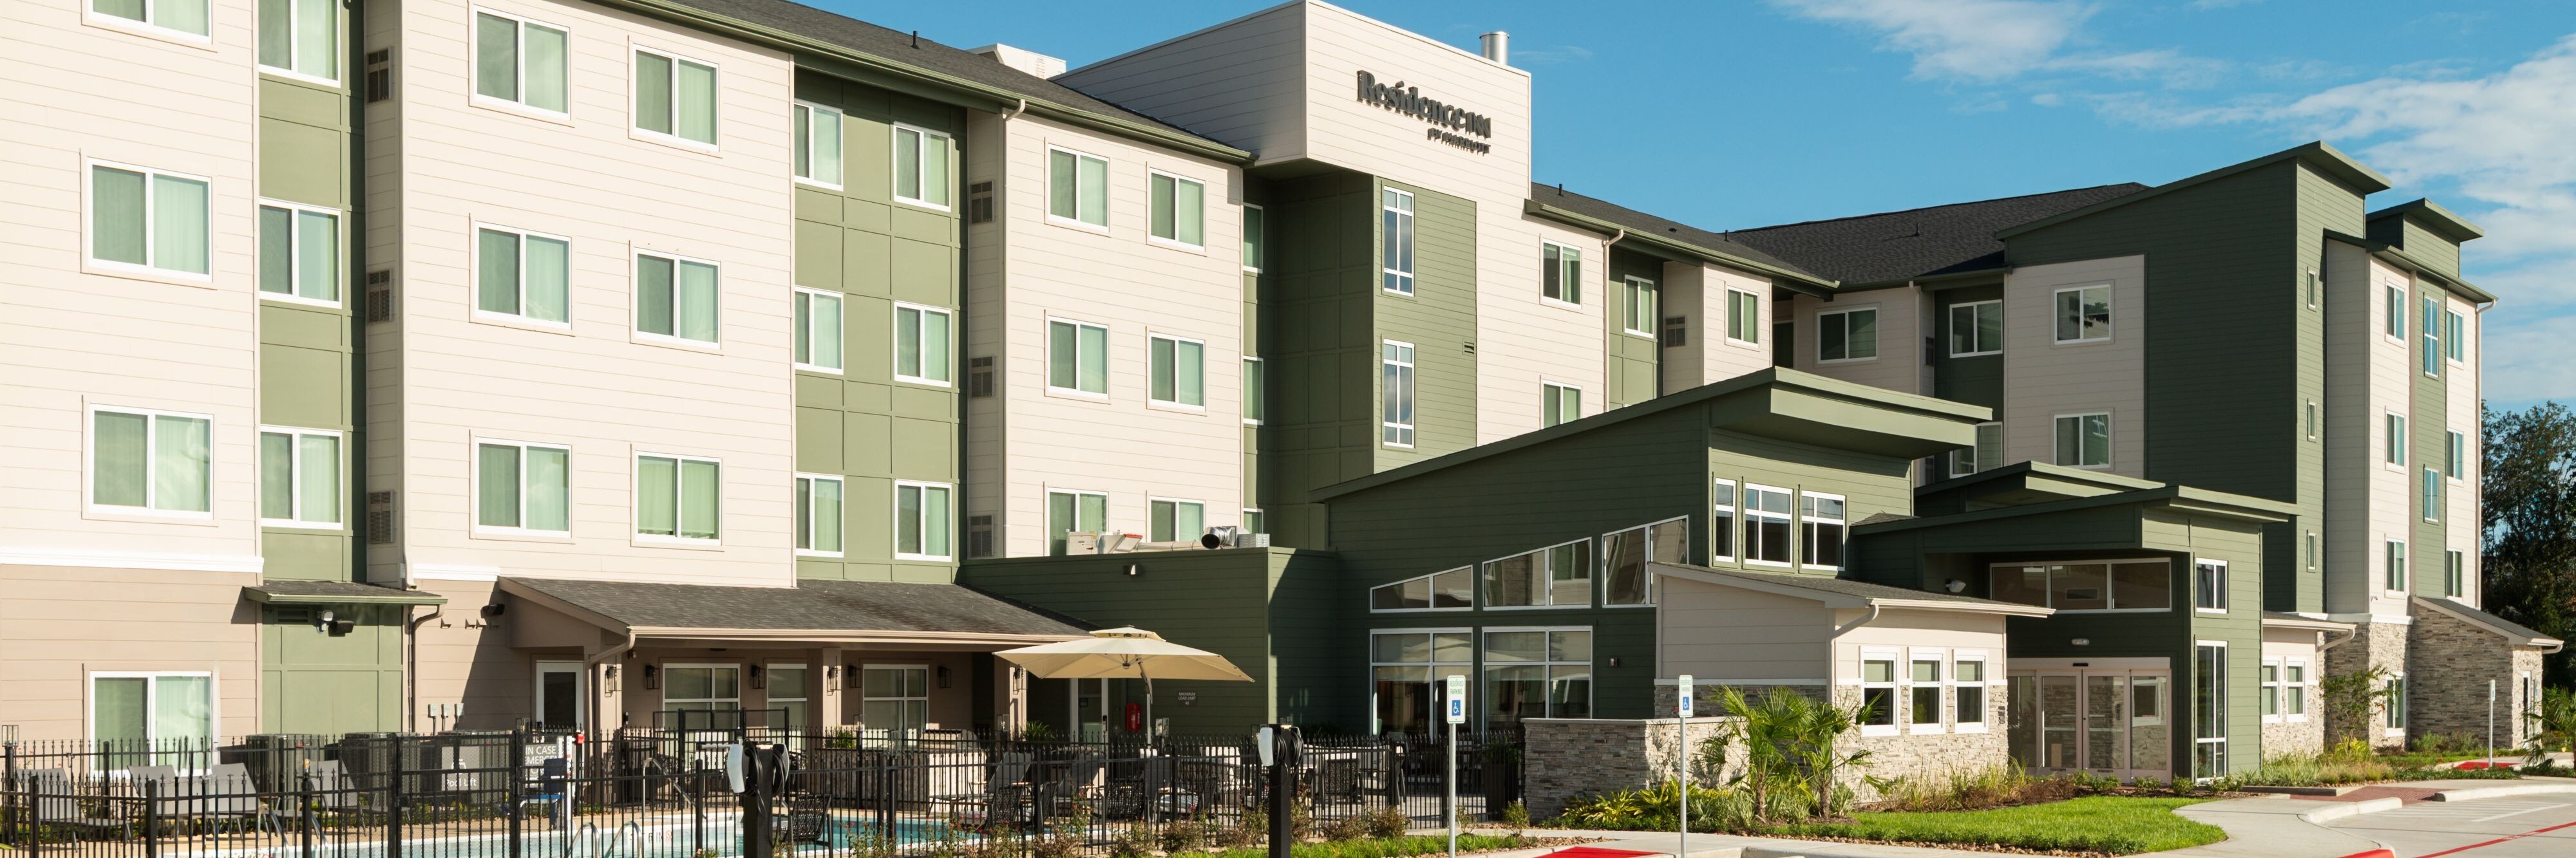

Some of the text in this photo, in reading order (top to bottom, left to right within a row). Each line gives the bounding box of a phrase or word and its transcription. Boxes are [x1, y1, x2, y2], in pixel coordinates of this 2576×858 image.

[1357, 70, 1466, 131] Residence
[526, 745, 557, 755] IN CASE
[464, 778, 477, 787] Lft
